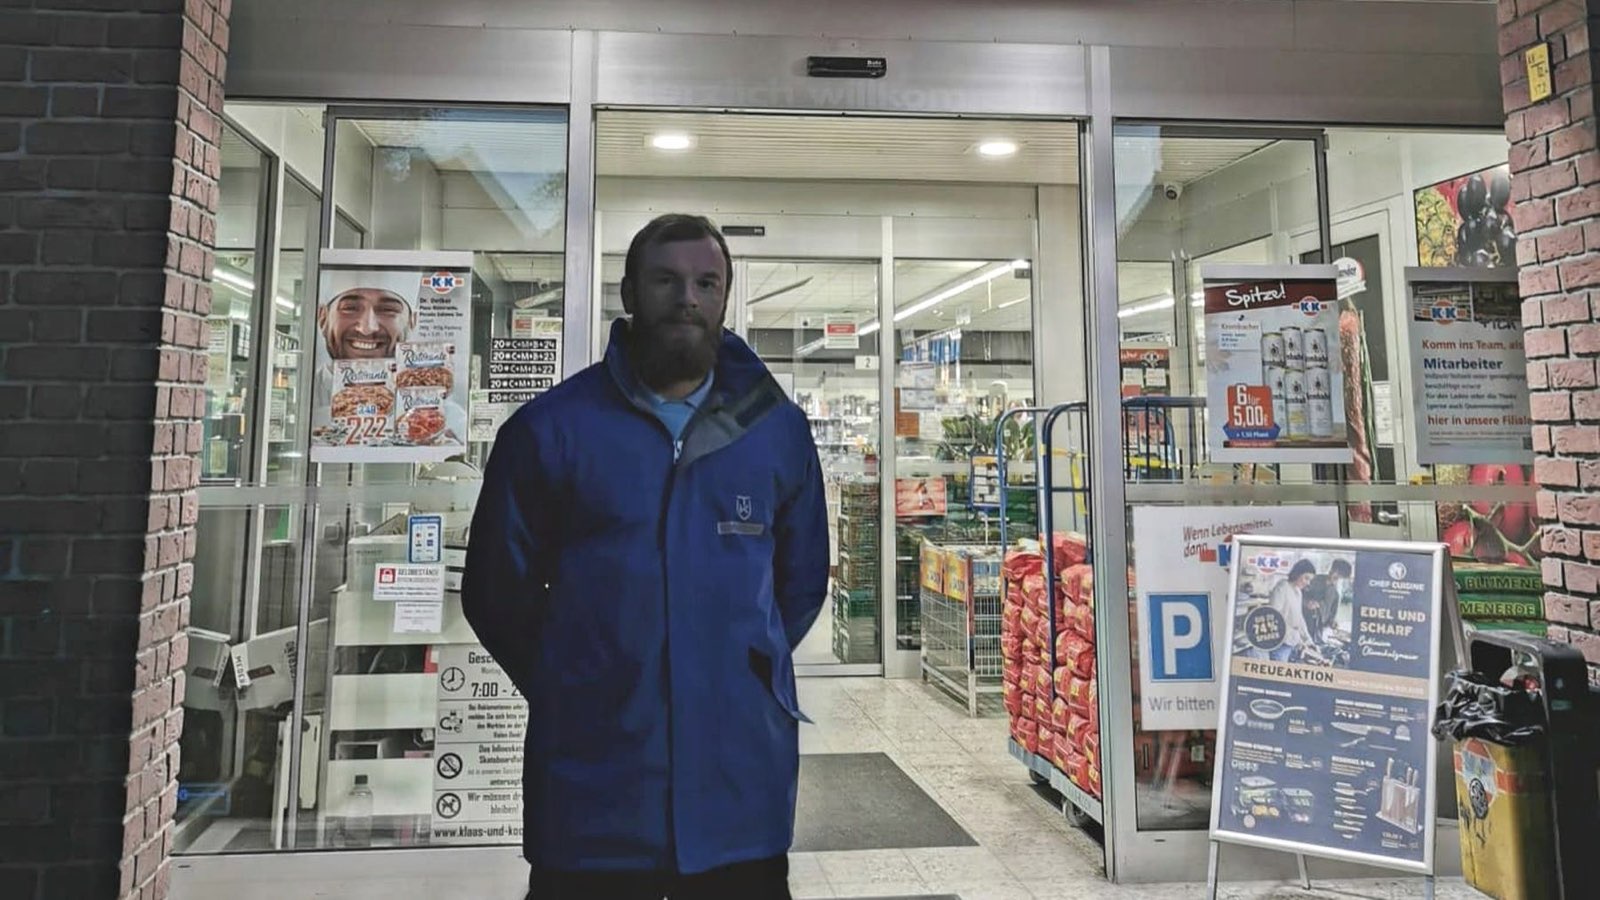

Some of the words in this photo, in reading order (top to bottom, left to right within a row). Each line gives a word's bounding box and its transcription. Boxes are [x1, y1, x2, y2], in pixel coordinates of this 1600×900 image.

[1225, 280, 1287, 308] Spitze!
[1422, 340, 1456, 350] Komm
[1459, 339, 1473, 349] ins
[865, 357, 871, 368] 2
[1423, 357, 1503, 369] Mitarbeiter
[341, 366, 388, 384] Ristorante
[1236, 384, 1248, 406] 6
[1427, 414, 1449, 425] hier
[1452, 415, 1461, 425] in
[1183, 525, 1209, 542] Wenn
[1183, 542, 1208, 558] dann
[1391, 581, 1425, 592] CUISINE
[1360, 605, 1394, 620] EDEL
[1397, 609, 1426, 623] UND
[1360, 621, 1414, 637] SCHARF
[1161, 601, 1203, 675] P
[1242, 662, 1335, 683] TREUEAKTION
[471, 682, 498, 697] 7:00
[1149, 696, 1173, 711] Wir
[1176, 696, 1215, 711] bitten
[467, 791, 480, 802] Wir
[482, 792, 511, 801] müssen
